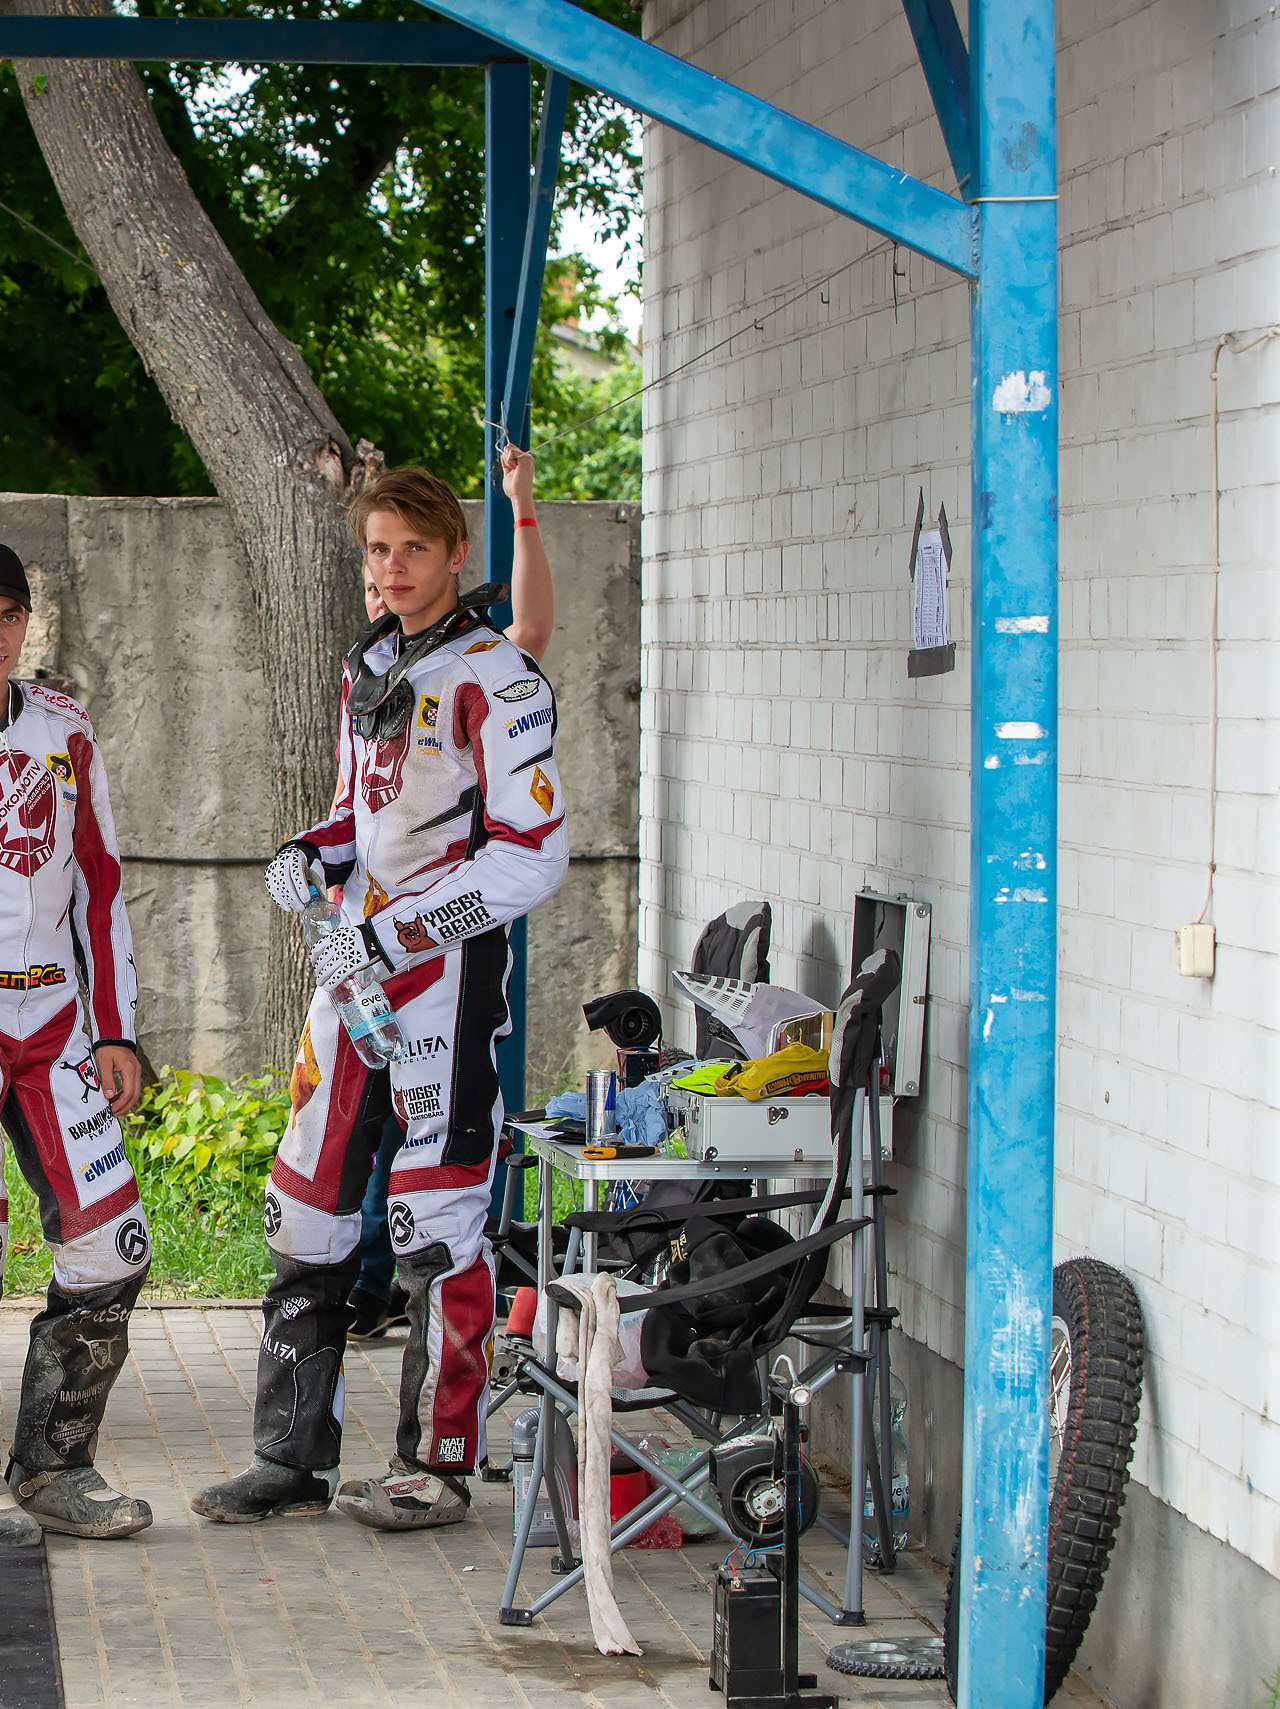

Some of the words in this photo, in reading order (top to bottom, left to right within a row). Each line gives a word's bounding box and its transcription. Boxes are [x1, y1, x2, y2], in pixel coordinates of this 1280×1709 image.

[29, 685, 89, 721] PitStop
[423, 889, 484, 928] YOGGY
[438, 906, 491, 940] BEAR
[443, 917, 498, 945] GASTROBARS
[403, 1083, 442, 1102] YOGGY
[408, 1098, 441, 1115] BEAR
[68, 1104, 113, 1140] BARANOWS
[439, 1446, 464, 1455] NIAK
[440, 1437, 466, 1446] MALI
